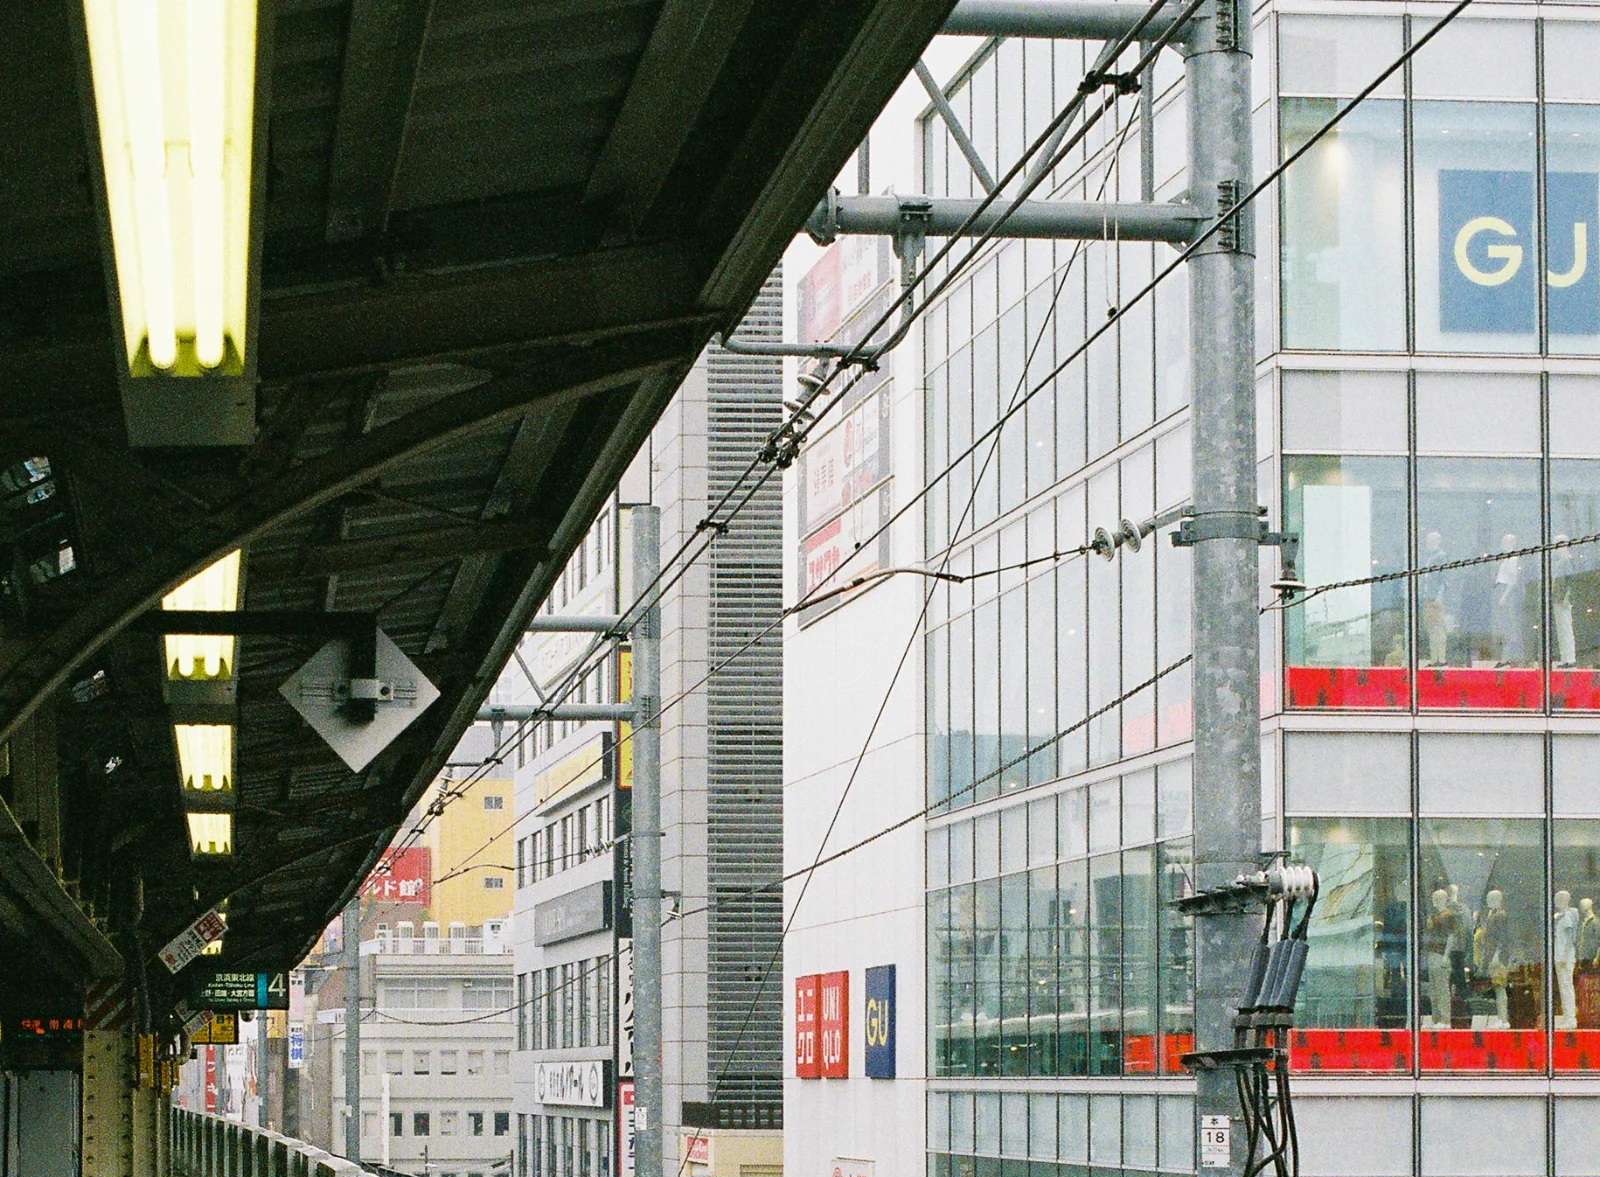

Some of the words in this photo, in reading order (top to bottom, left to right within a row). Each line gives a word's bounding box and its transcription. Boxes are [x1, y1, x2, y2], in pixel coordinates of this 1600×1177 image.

[1454, 216, 1587, 288] GU
[268, 973, 286, 997] 4
[797, 988, 814, 1022] ユニ
[823, 986, 840, 1021] UNI
[866, 998, 889, 1047] GU
[797, 1032, 814, 1064] クロ
[823, 1029, 841, 1070] QLO
[1206, 1131, 1225, 1143] 18
